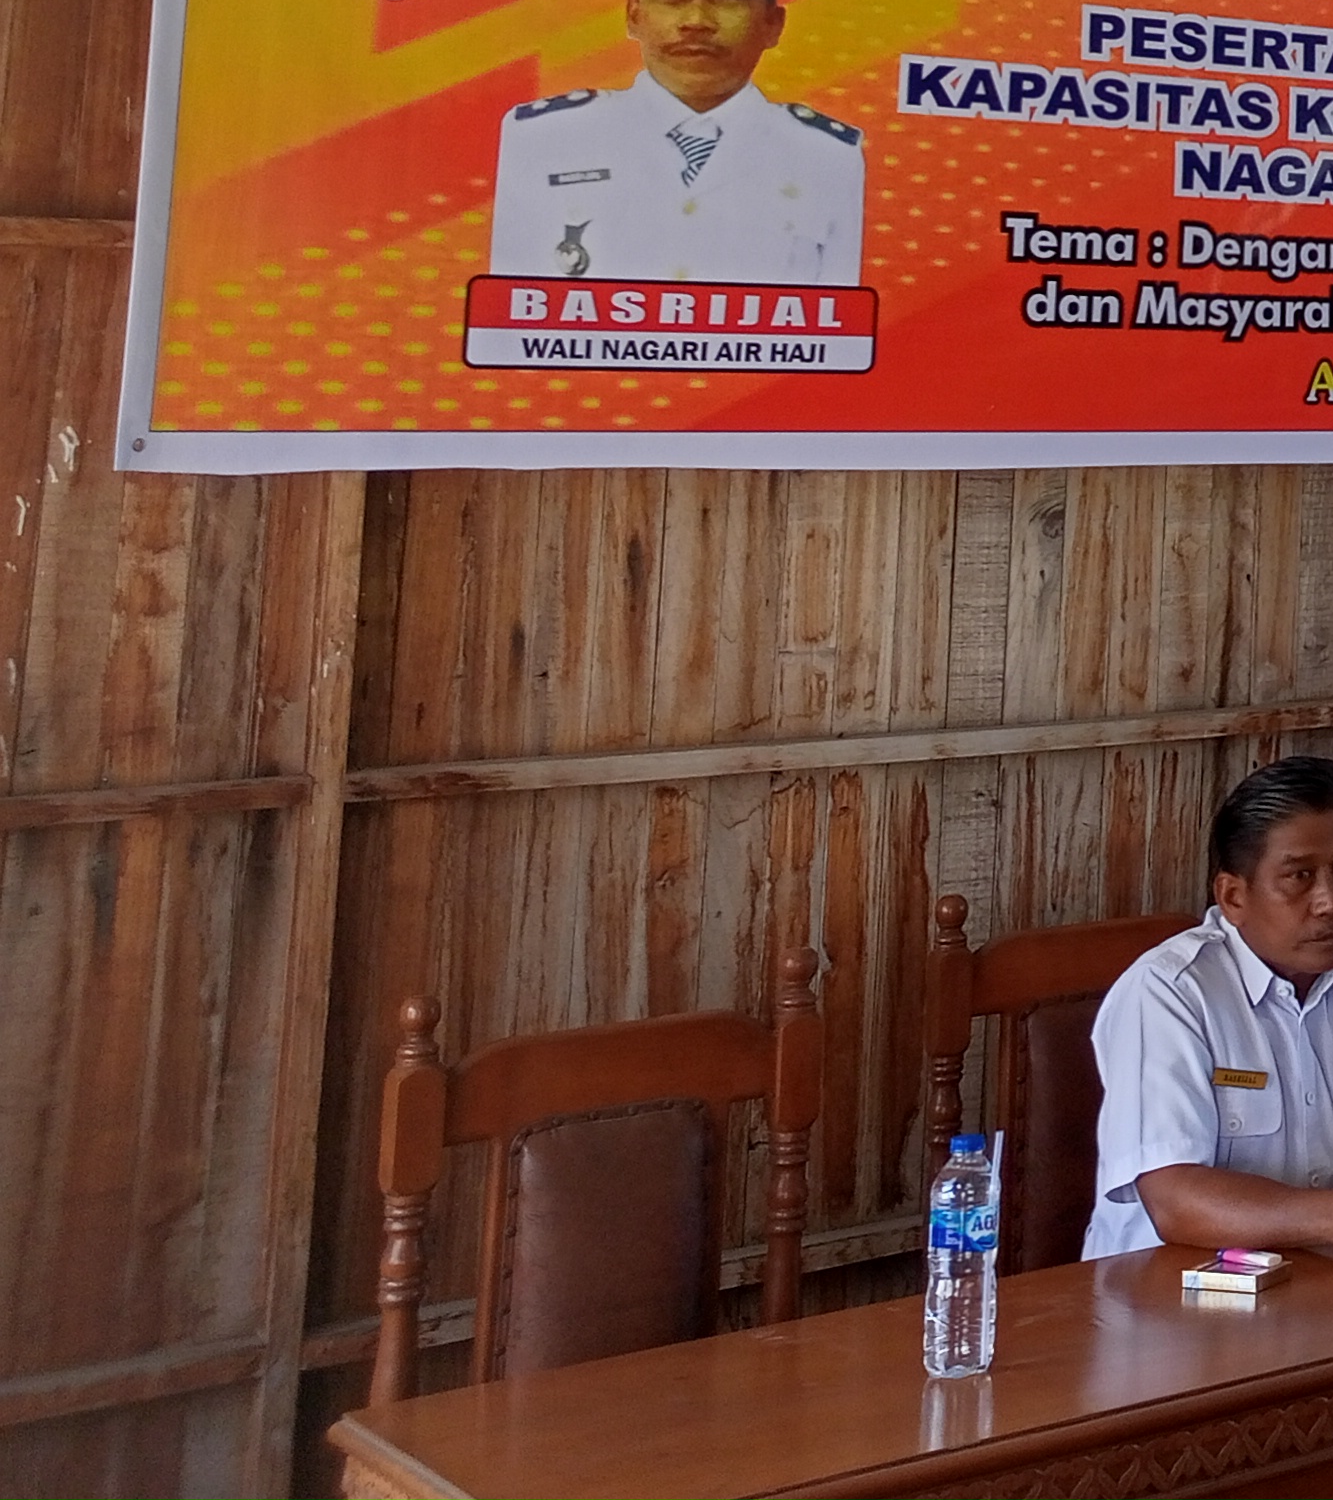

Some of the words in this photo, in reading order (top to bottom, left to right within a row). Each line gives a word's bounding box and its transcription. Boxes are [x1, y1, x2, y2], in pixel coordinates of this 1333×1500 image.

[904, 61, 1275, 132] KAPASITAS
[1004, 216, 1136, 264] Tema
[509, 287, 843, 329] BASRIJAL
[1025, 279, 1121, 325] dan
[521, 337, 593, 361] WALI
[600, 338, 709, 363] NAGARI
[714, 341, 763, 364] AIR
[769, 343, 827, 365] HAJI
